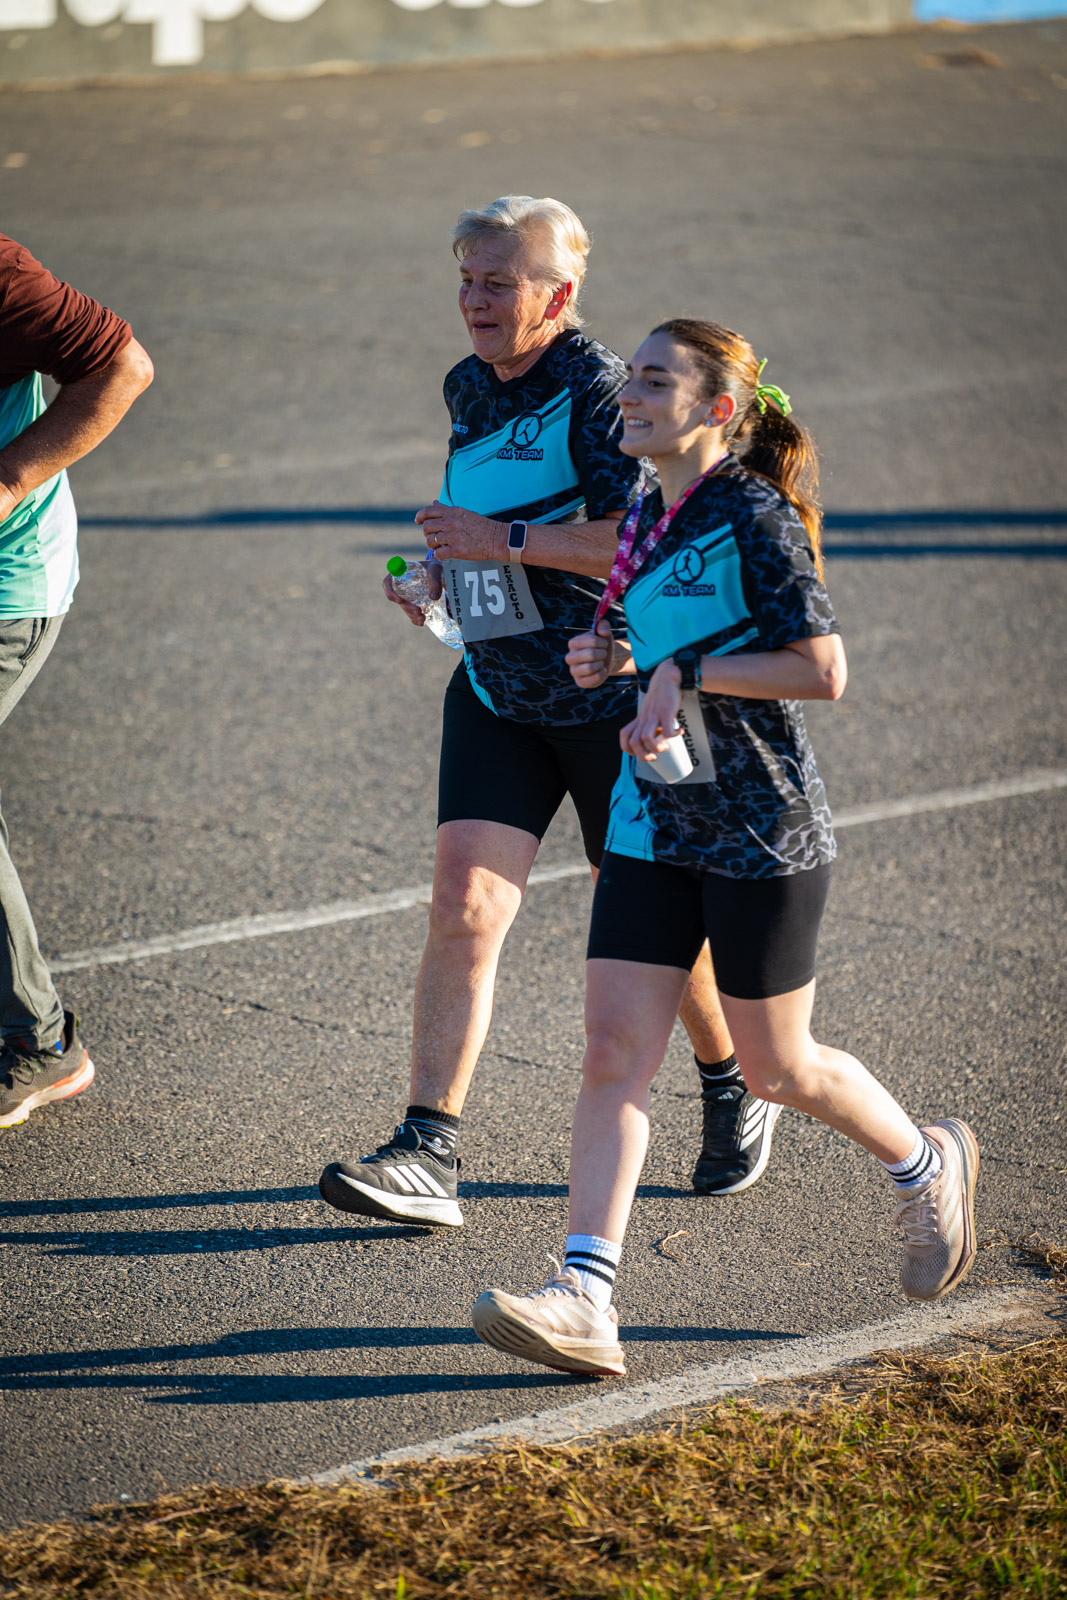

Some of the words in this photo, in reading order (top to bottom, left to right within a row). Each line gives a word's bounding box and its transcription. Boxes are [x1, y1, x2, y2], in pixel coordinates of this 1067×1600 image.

[514, 448, 544, 461] TEAM
[450, 569, 463, 626] TIEMPO
[463, 569, 506, 617] 75
[503, 565, 524, 620] EXACTO
[681, 584, 716, 597] TEAM
